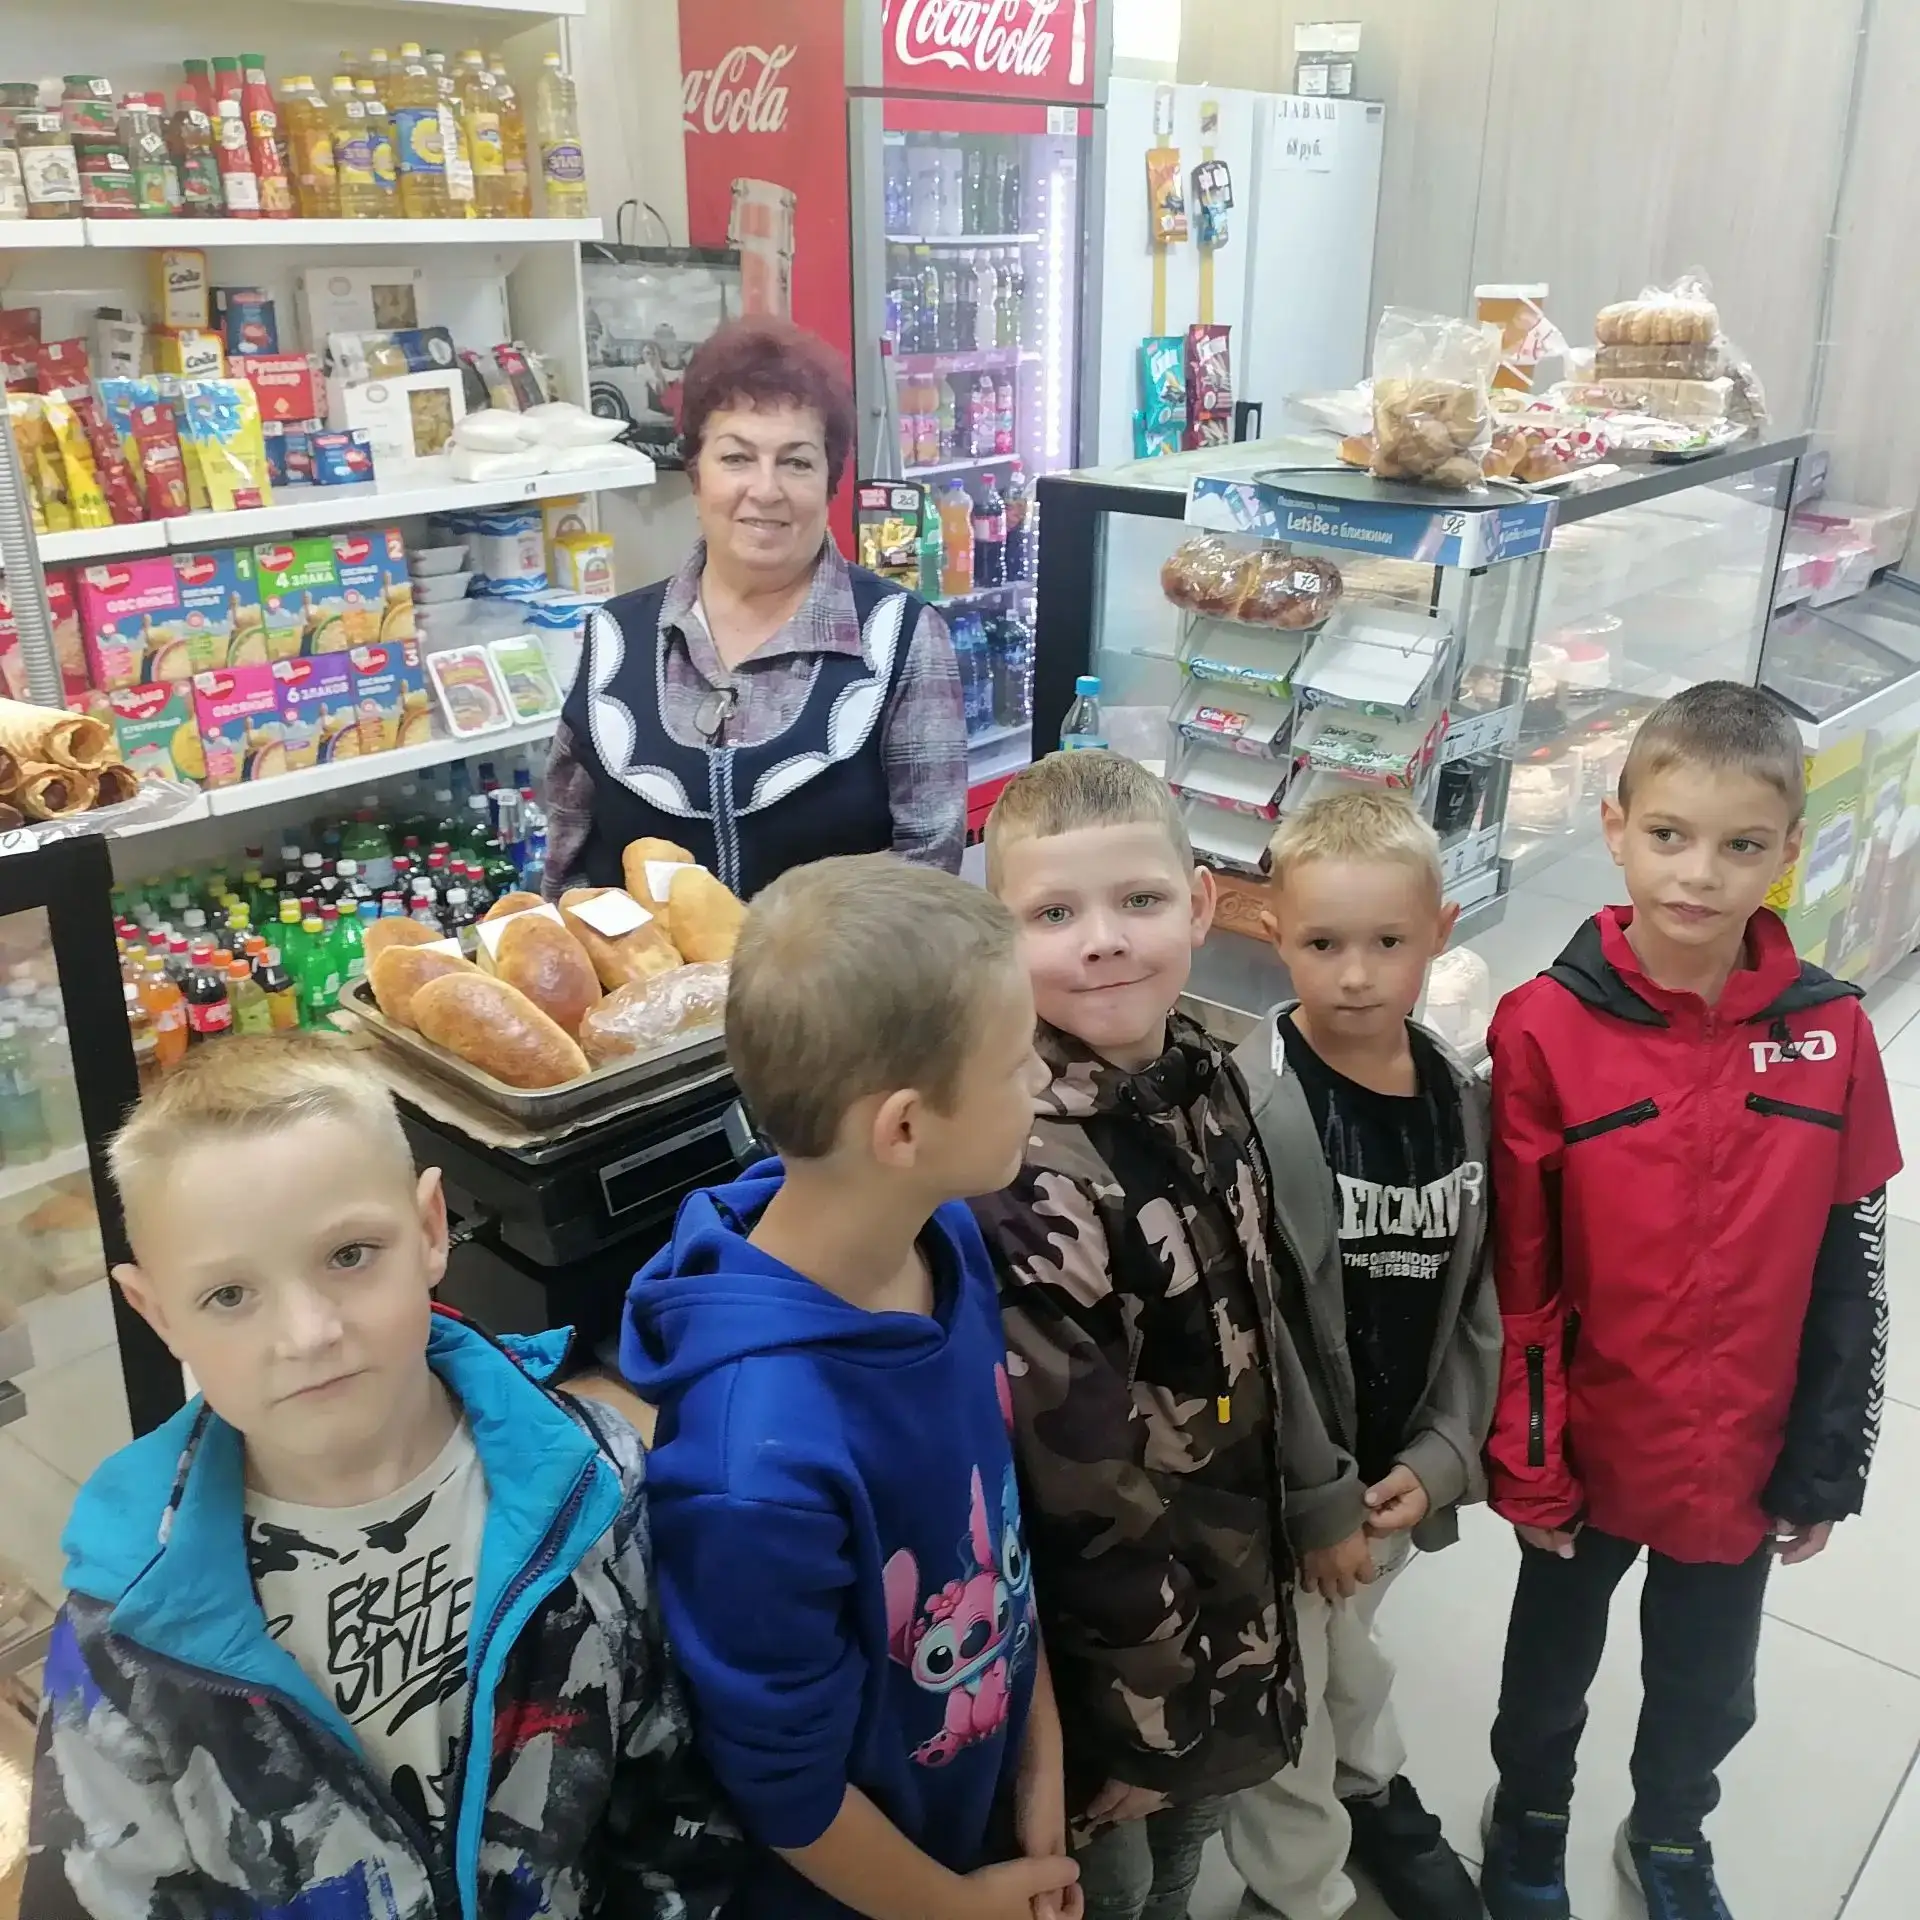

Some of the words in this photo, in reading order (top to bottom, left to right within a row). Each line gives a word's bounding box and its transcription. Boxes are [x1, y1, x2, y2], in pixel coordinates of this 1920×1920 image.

[1277, 100, 1336, 120] ЛАВАШ
[168, 268, 201, 286] Сода
[185, 351, 218, 369] Сода
[1441, 517, 1466, 535] 98
[387, 540, 403, 560] 2
[237, 559, 251, 578] 1
[275, 573, 290, 588] 4
[290, 571, 334, 586] ЗЛАКА
[405, 648, 419, 667] 3
[286, 687, 300, 704] 6
[1342, 1252, 1370, 1267] THE
[1384, 1263, 1440, 1280] DESERT
[327, 1543, 453, 1642] FREE
[327, 1577, 474, 1715] STYLE
